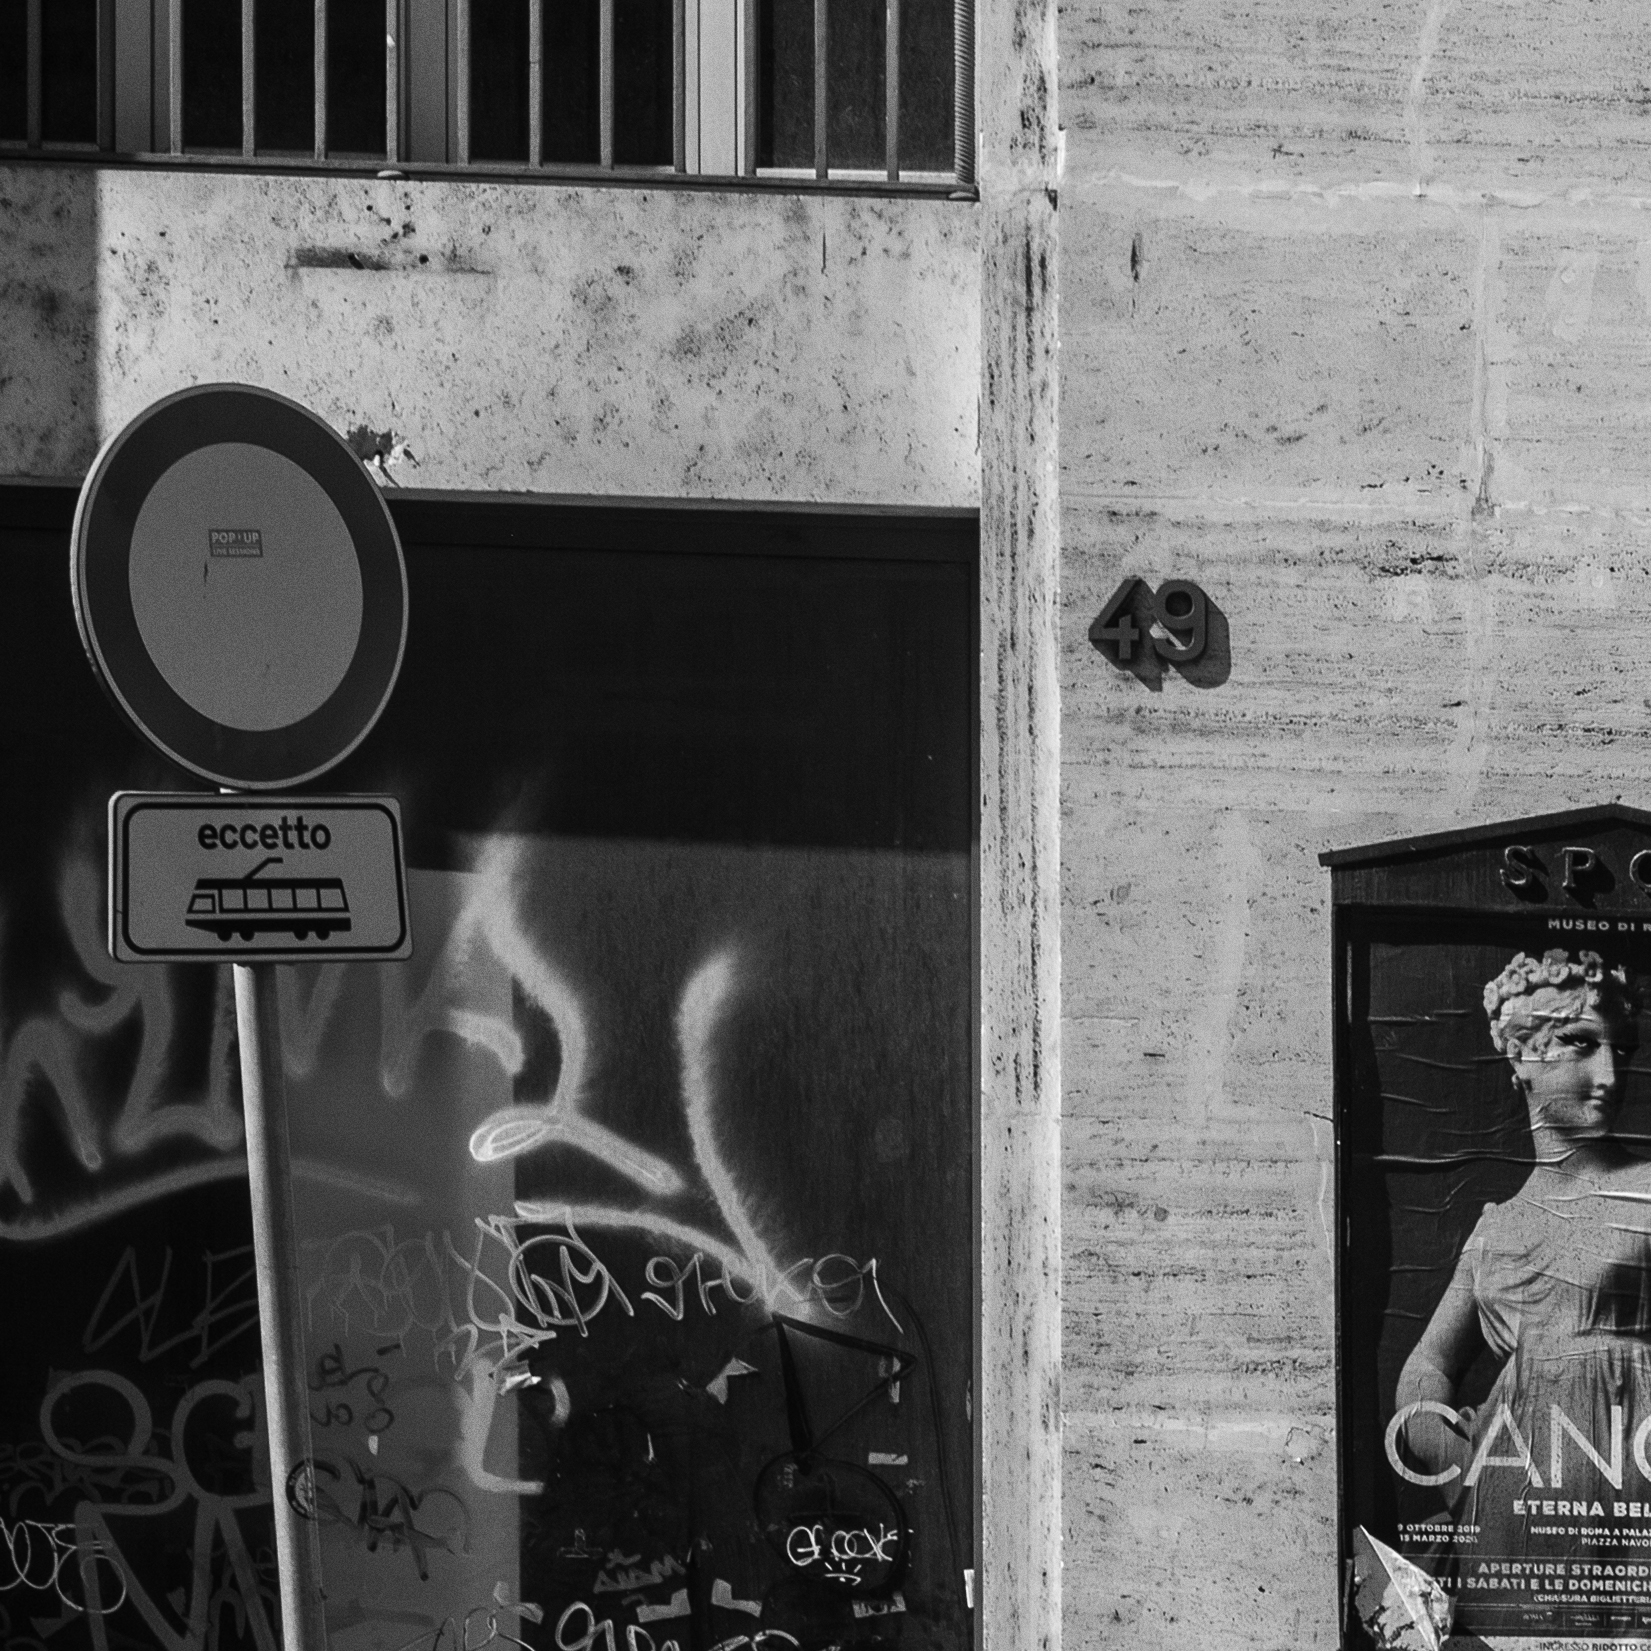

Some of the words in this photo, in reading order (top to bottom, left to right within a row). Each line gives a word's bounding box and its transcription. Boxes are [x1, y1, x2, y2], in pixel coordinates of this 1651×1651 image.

[1088, 578, 1208, 662] 49
[198, 815, 332, 853] eccetto
[1547, 917, 1610, 933] MUSEO
[1617, 920, 1637, 934] DI
[1513, 1499, 1605, 1518] ETERNA
[1406, 1523, 1454, 1533] OTTOBRE
[1530, 1526, 1565, 1535] MUSEO
[1567, 1527, 1579, 1536] DI
[1581, 1527, 1611, 1536] ROMA
[1613, 1528, 1620, 1537] A
[1412, 1534, 1449, 1543] MARZO
[1581, 1537, 1619, 1546] PIAZZA
[1477, 1562, 1566, 1576] APERTURE
[1466, 1576, 1526, 1590] SABATI
[1530, 1578, 1540, 1590] E
[1544, 1578, 1564, 1590] LE
[1539, 1641, 1590, 1651] INGRESSO
